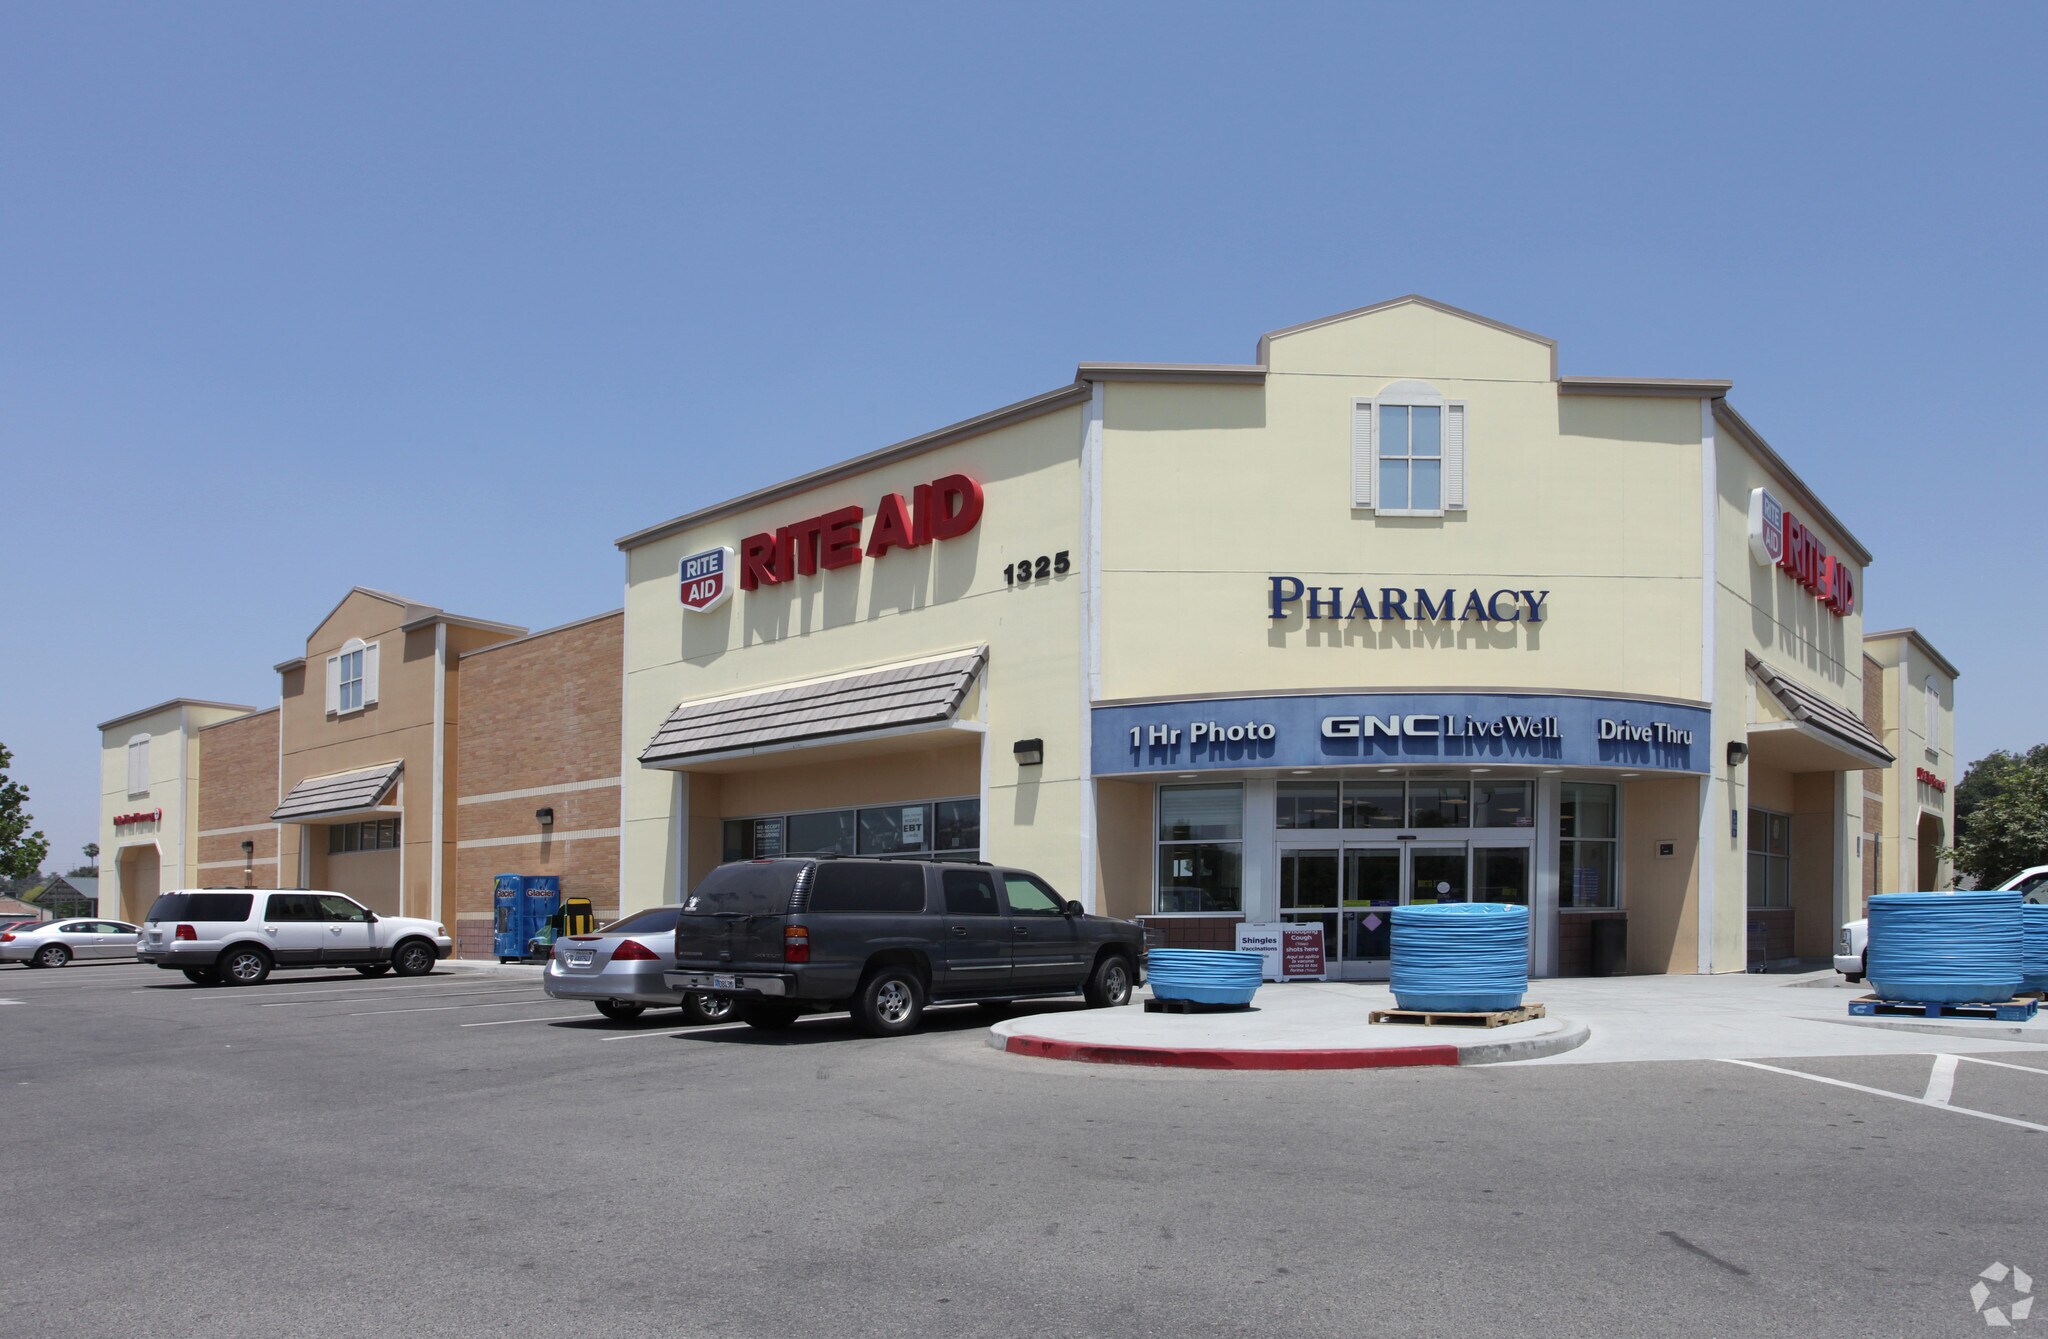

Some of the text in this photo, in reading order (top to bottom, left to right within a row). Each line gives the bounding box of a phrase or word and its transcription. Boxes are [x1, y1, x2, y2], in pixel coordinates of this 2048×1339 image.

[1764, 498, 1780, 527] RITE
[740, 474, 984, 591] RITE AID
[1765, 527, 1779, 552] AID
[687, 554, 719, 578] RITE
[1004, 550, 1070, 585] 1325
[1782, 512, 1854, 617] RITE AID
[688, 583, 716, 602] AID
[1129, 721, 1276, 747] 1 Hr Photo
[1321, 714, 1440, 738] GNC
[1601, 719, 1693, 745] Drive Thru
[904, 824, 922, 832] EBT
[526, 888, 556, 897] Glacier
[1242, 937, 1277, 945] Shingles
